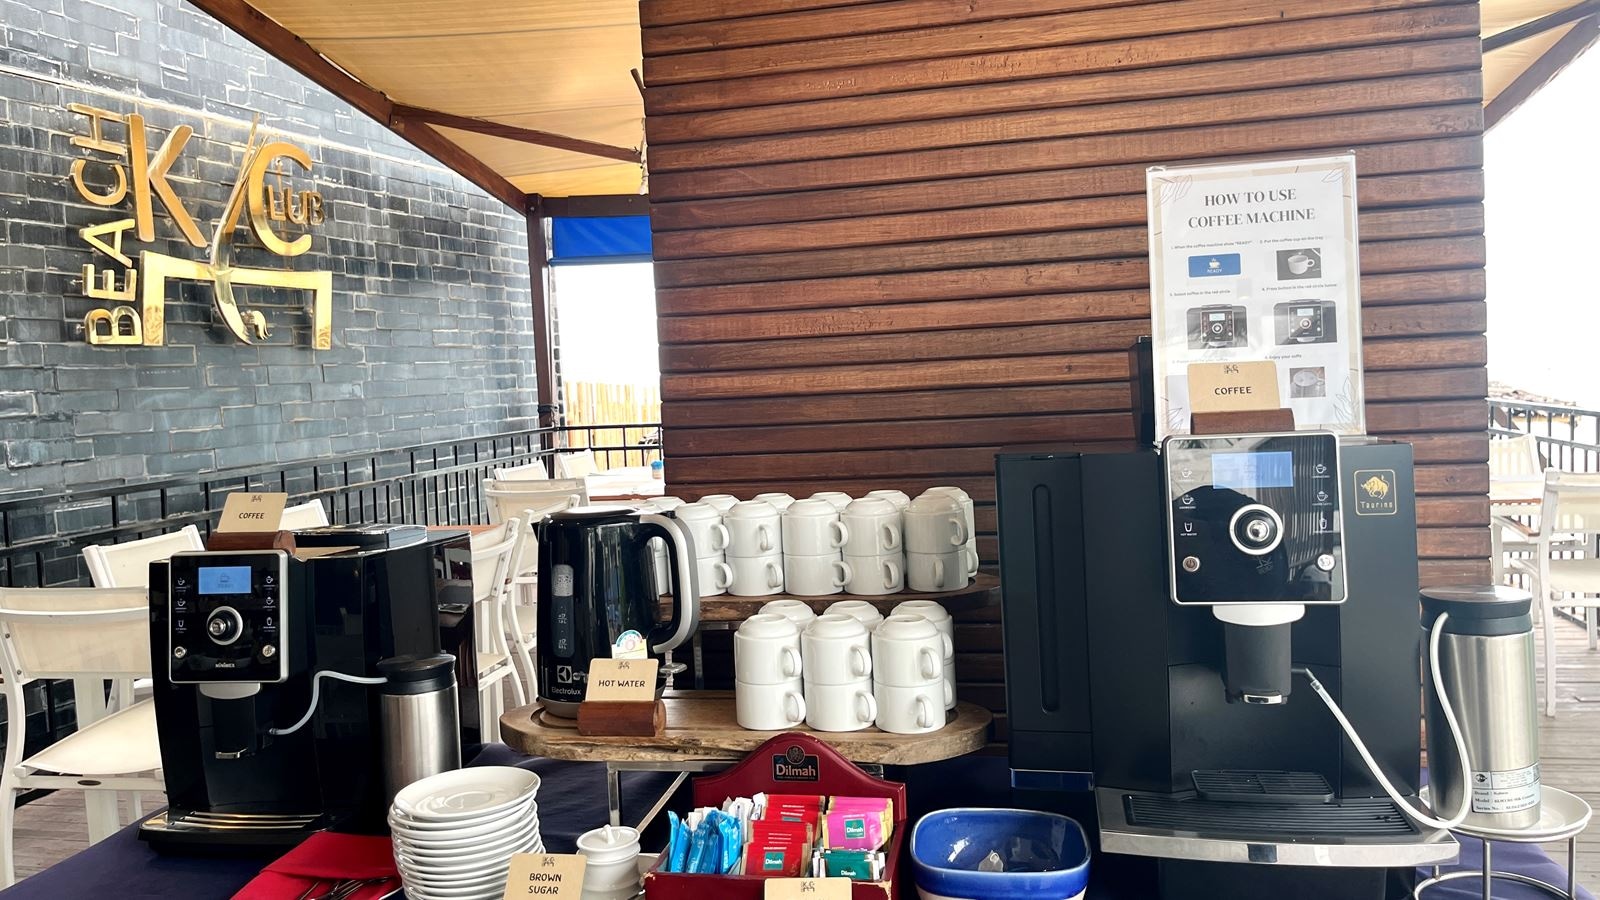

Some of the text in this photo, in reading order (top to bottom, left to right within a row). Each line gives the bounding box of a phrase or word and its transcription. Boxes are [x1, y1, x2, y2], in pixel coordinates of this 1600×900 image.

[1204, 188, 1297, 207] HOW TO USE
[1188, 208, 1316, 229] COFFEE MACHINE
[67, 103, 143, 345] BEACH
[1214, 386, 1252, 395] COFFEE
[238, 512, 265, 520] COFFEE
[617, 680, 646, 688] WATER
[551, 686, 582, 695] Electrolux
[776, 763, 816, 777] Dilmah
[765, 857, 783, 865] Dilmah
[529, 872, 562, 882] BROWN
[528, 885, 559, 895] SUGAR
